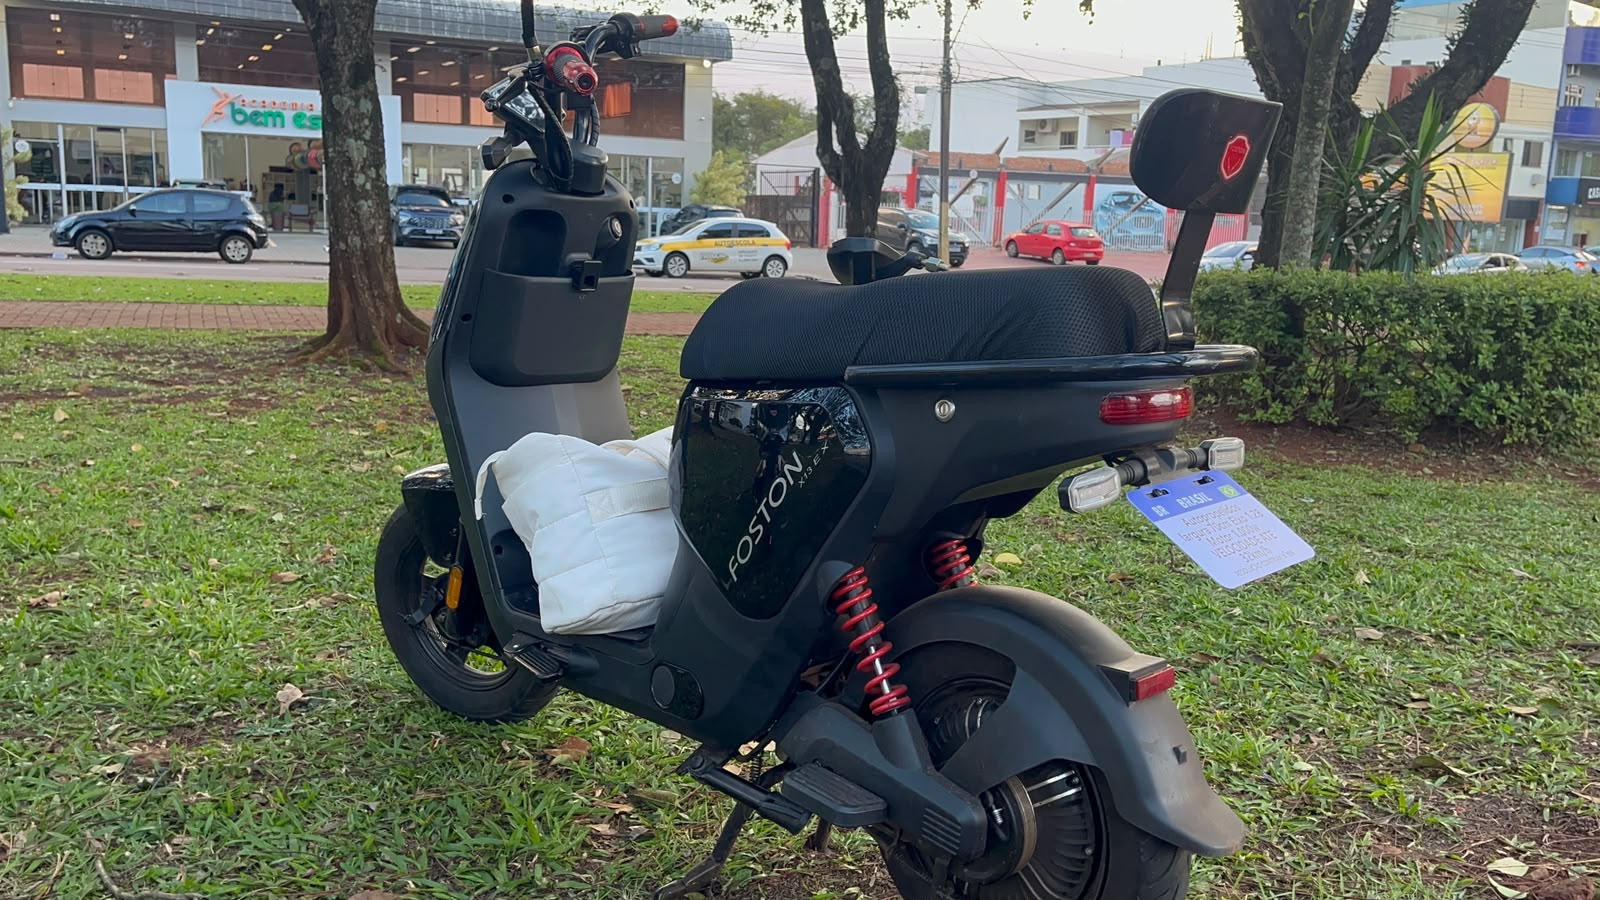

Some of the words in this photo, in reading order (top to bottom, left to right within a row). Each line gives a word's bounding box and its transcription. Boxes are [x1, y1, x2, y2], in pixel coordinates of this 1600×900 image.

[231, 102, 285, 128] bem
[728, 451, 804, 583] FOSTON
[1151, 505, 1170, 517] BR
[1176, 492, 1213, 508] BRASIL
[1211, 534, 1263, 559] VELOCIDADE
